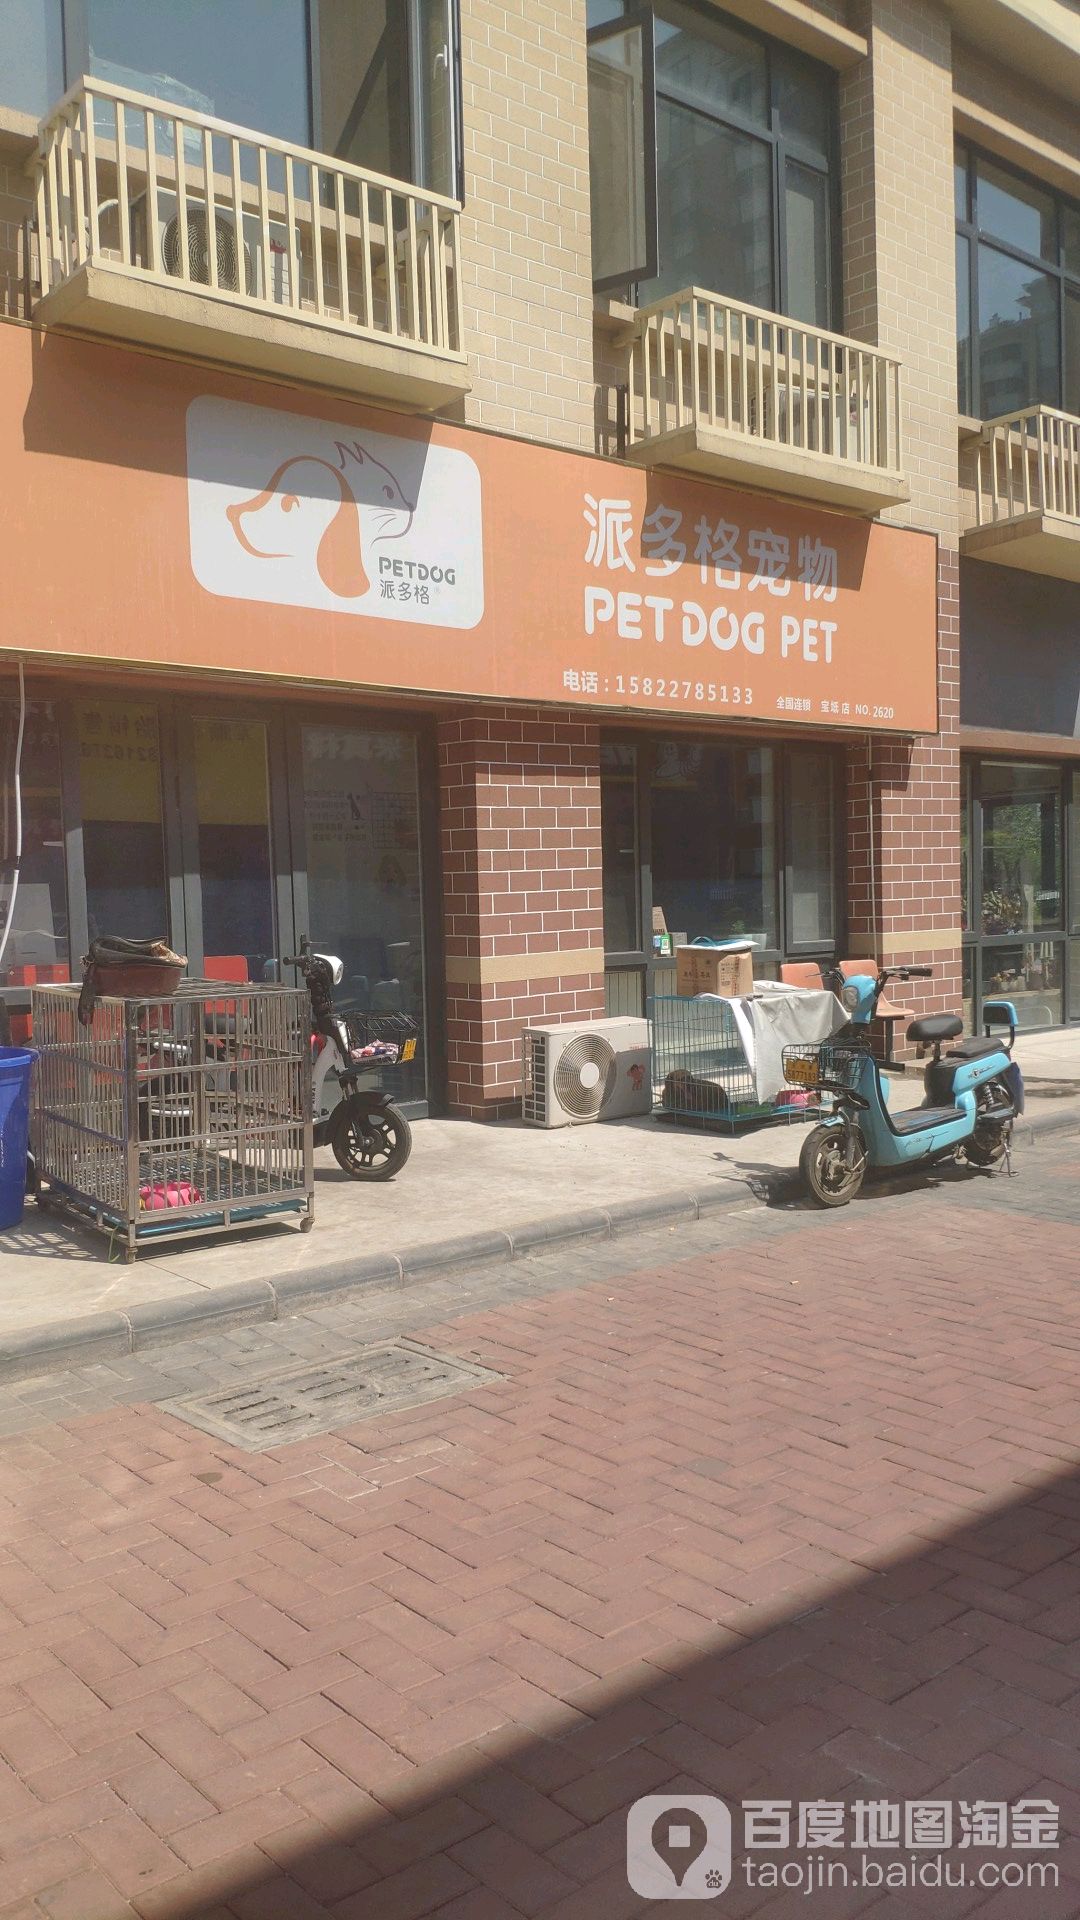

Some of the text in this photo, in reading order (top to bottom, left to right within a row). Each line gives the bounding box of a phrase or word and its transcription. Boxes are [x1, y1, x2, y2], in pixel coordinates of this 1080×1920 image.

[583, 492, 838, 602] 派多格宠物
[379, 556, 455, 585] PETDOG
[380, 579, 430, 605] 派多格
[584, 585, 838, 664] PET DOG PET
[776, 696, 811, 712] 全国连锁
